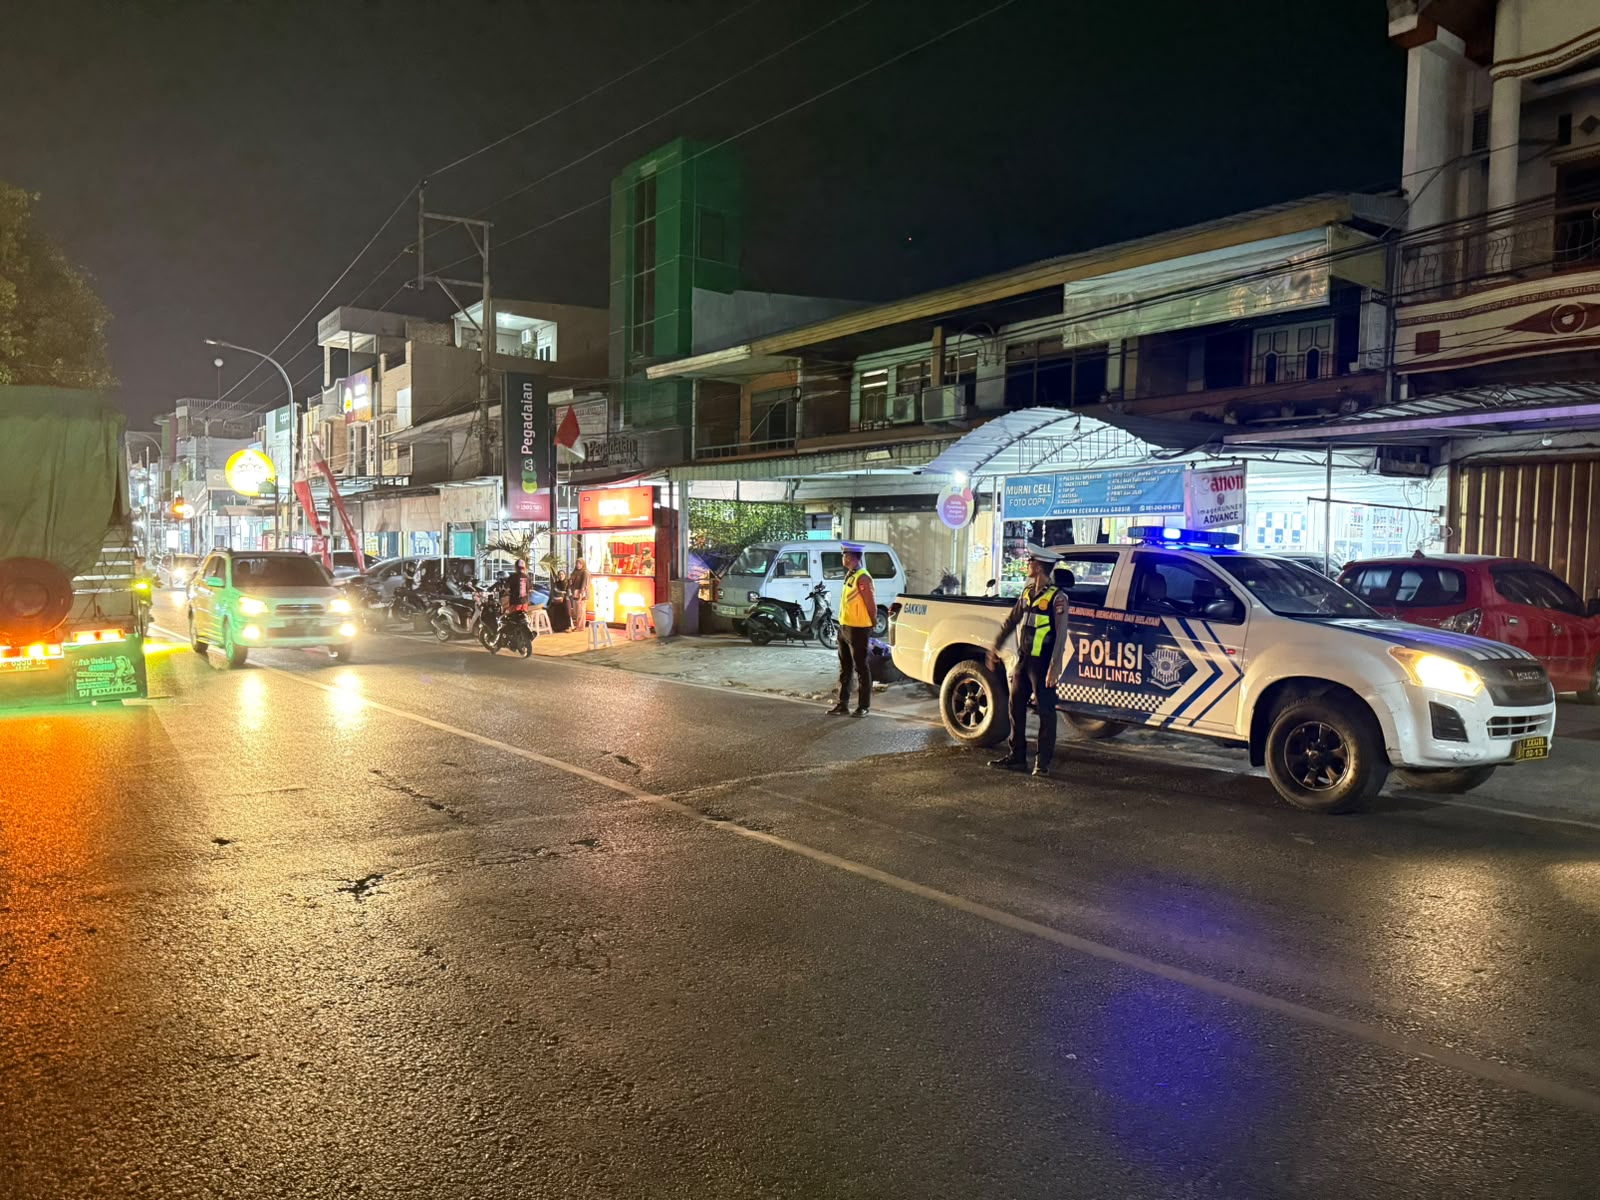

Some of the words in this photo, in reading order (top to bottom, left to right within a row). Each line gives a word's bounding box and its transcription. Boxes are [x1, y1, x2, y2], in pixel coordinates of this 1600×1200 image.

[521, 382, 536, 455] Pegadaian
[1006, 485, 1031, 496] MURNI
[1033, 483, 1052, 493] CELL
[1009, 498, 1026, 507] FOTO
[1027, 497, 1046, 506] COPY
[1203, 511, 1239, 524] ADVANCE
[1078, 638, 1143, 670] POLISI
[1078, 665, 1103, 680] LALU
[1105, 669, 1143, 685] LINTAS
